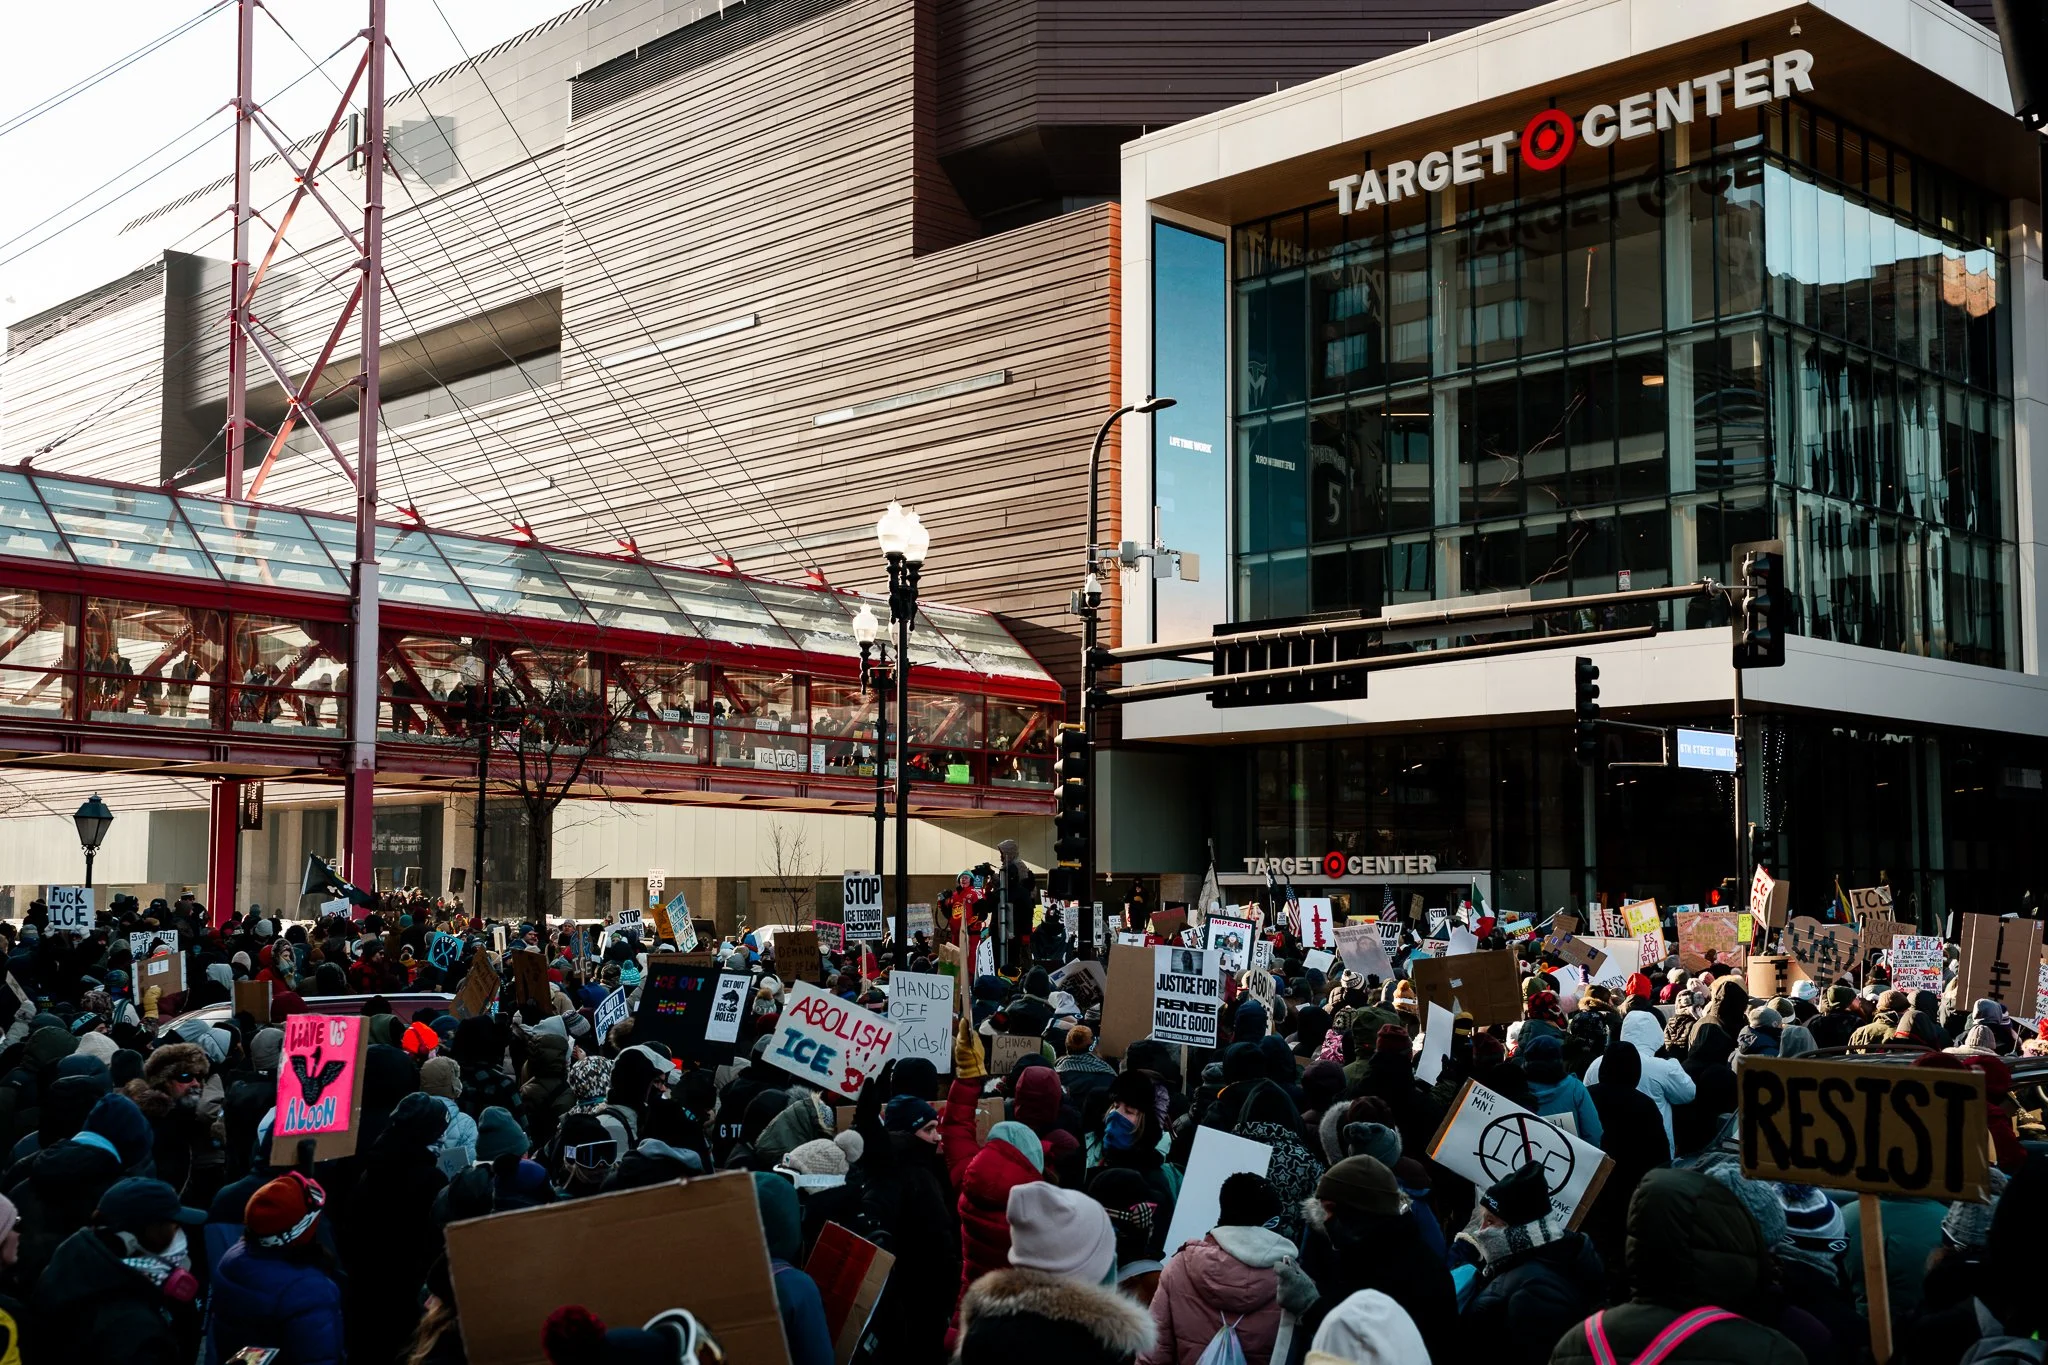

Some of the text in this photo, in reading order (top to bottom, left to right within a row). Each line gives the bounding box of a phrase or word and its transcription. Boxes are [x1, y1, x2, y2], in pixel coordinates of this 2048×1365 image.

[1329, 49, 1815, 216] TARGET CENTER
[1692, 744, 1715, 756] STREET
[760, 753, 773, 764] ICE
[1243, 854, 1437, 876] TARGET CENTER
[649, 879, 663, 888] 25
[845, 878, 880, 905] STOP
[50, 905, 88, 927] ICE
[619, 909, 641, 924] STOP
[845, 909, 880, 922] ICE TERROR
[846, 922, 880, 931] NOW!
[1211, 918, 1251, 930] IMPEACH
[160, 932, 176, 942] my
[680, 935, 696, 953] ICE
[1898, 939, 1943, 950] AMERICA
[1897, 967, 1918, 975] RIOTS
[679, 977, 705, 991] OUT
[722, 980, 745, 989] GET OUT
[896, 977, 950, 999] HANDS
[1157, 974, 1217, 997] JUSTICE FOR
[716, 1002, 727, 1012] ICE
[890, 1001, 928, 1018] OFF
[1156, 997, 1217, 1015] RENEE
[714, 1012, 738, 1023] HOLES!
[789, 995, 893, 1055] ABOLISH
[1155, 1010, 1216, 1034] NICOLE GOOD
[290, 1020, 348, 1052] LEAVE US
[896, 1025, 948, 1057] Kids!!
[996, 1036, 1032, 1049] CHINGA
[776, 1027, 838, 1075] ICE
[1006, 1050, 1018, 1059] LA
[1471, 1085, 1497, 1104] LEAVE
[1742, 1069, 1978, 1193] RESIST
